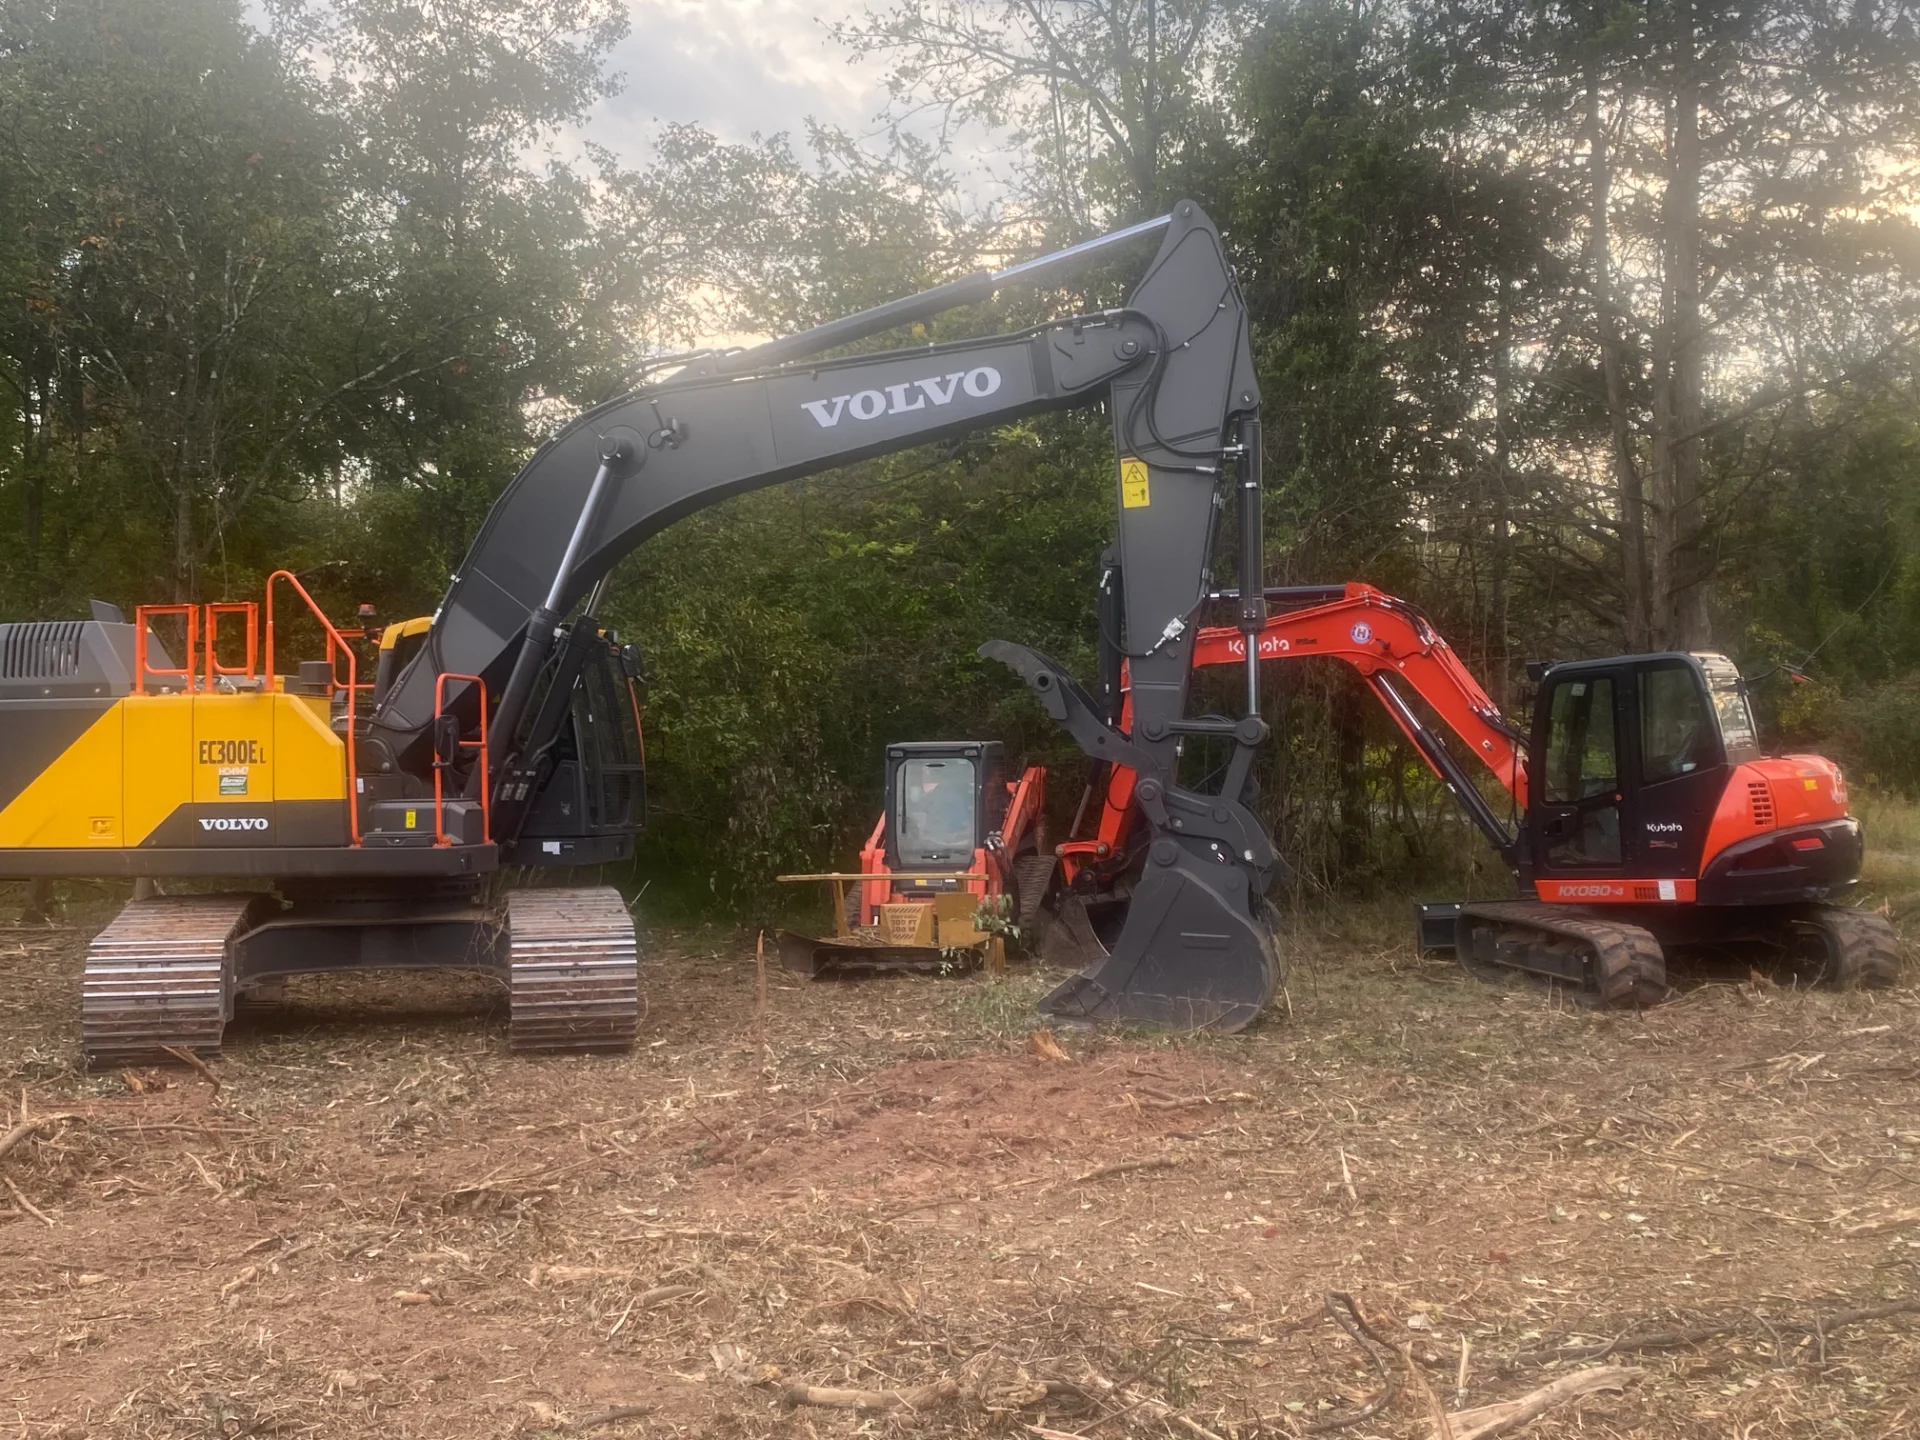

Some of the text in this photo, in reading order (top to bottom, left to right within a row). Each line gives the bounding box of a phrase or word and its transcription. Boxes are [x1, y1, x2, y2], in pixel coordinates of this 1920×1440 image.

[801, 366, 1002, 428] VOLVO
[1228, 636, 1290, 655] Kota
[198, 818, 268, 830] VOLVO
[1646, 822, 1683, 833] Kubota
[1558, 885, 1624, 897] KX080-4
